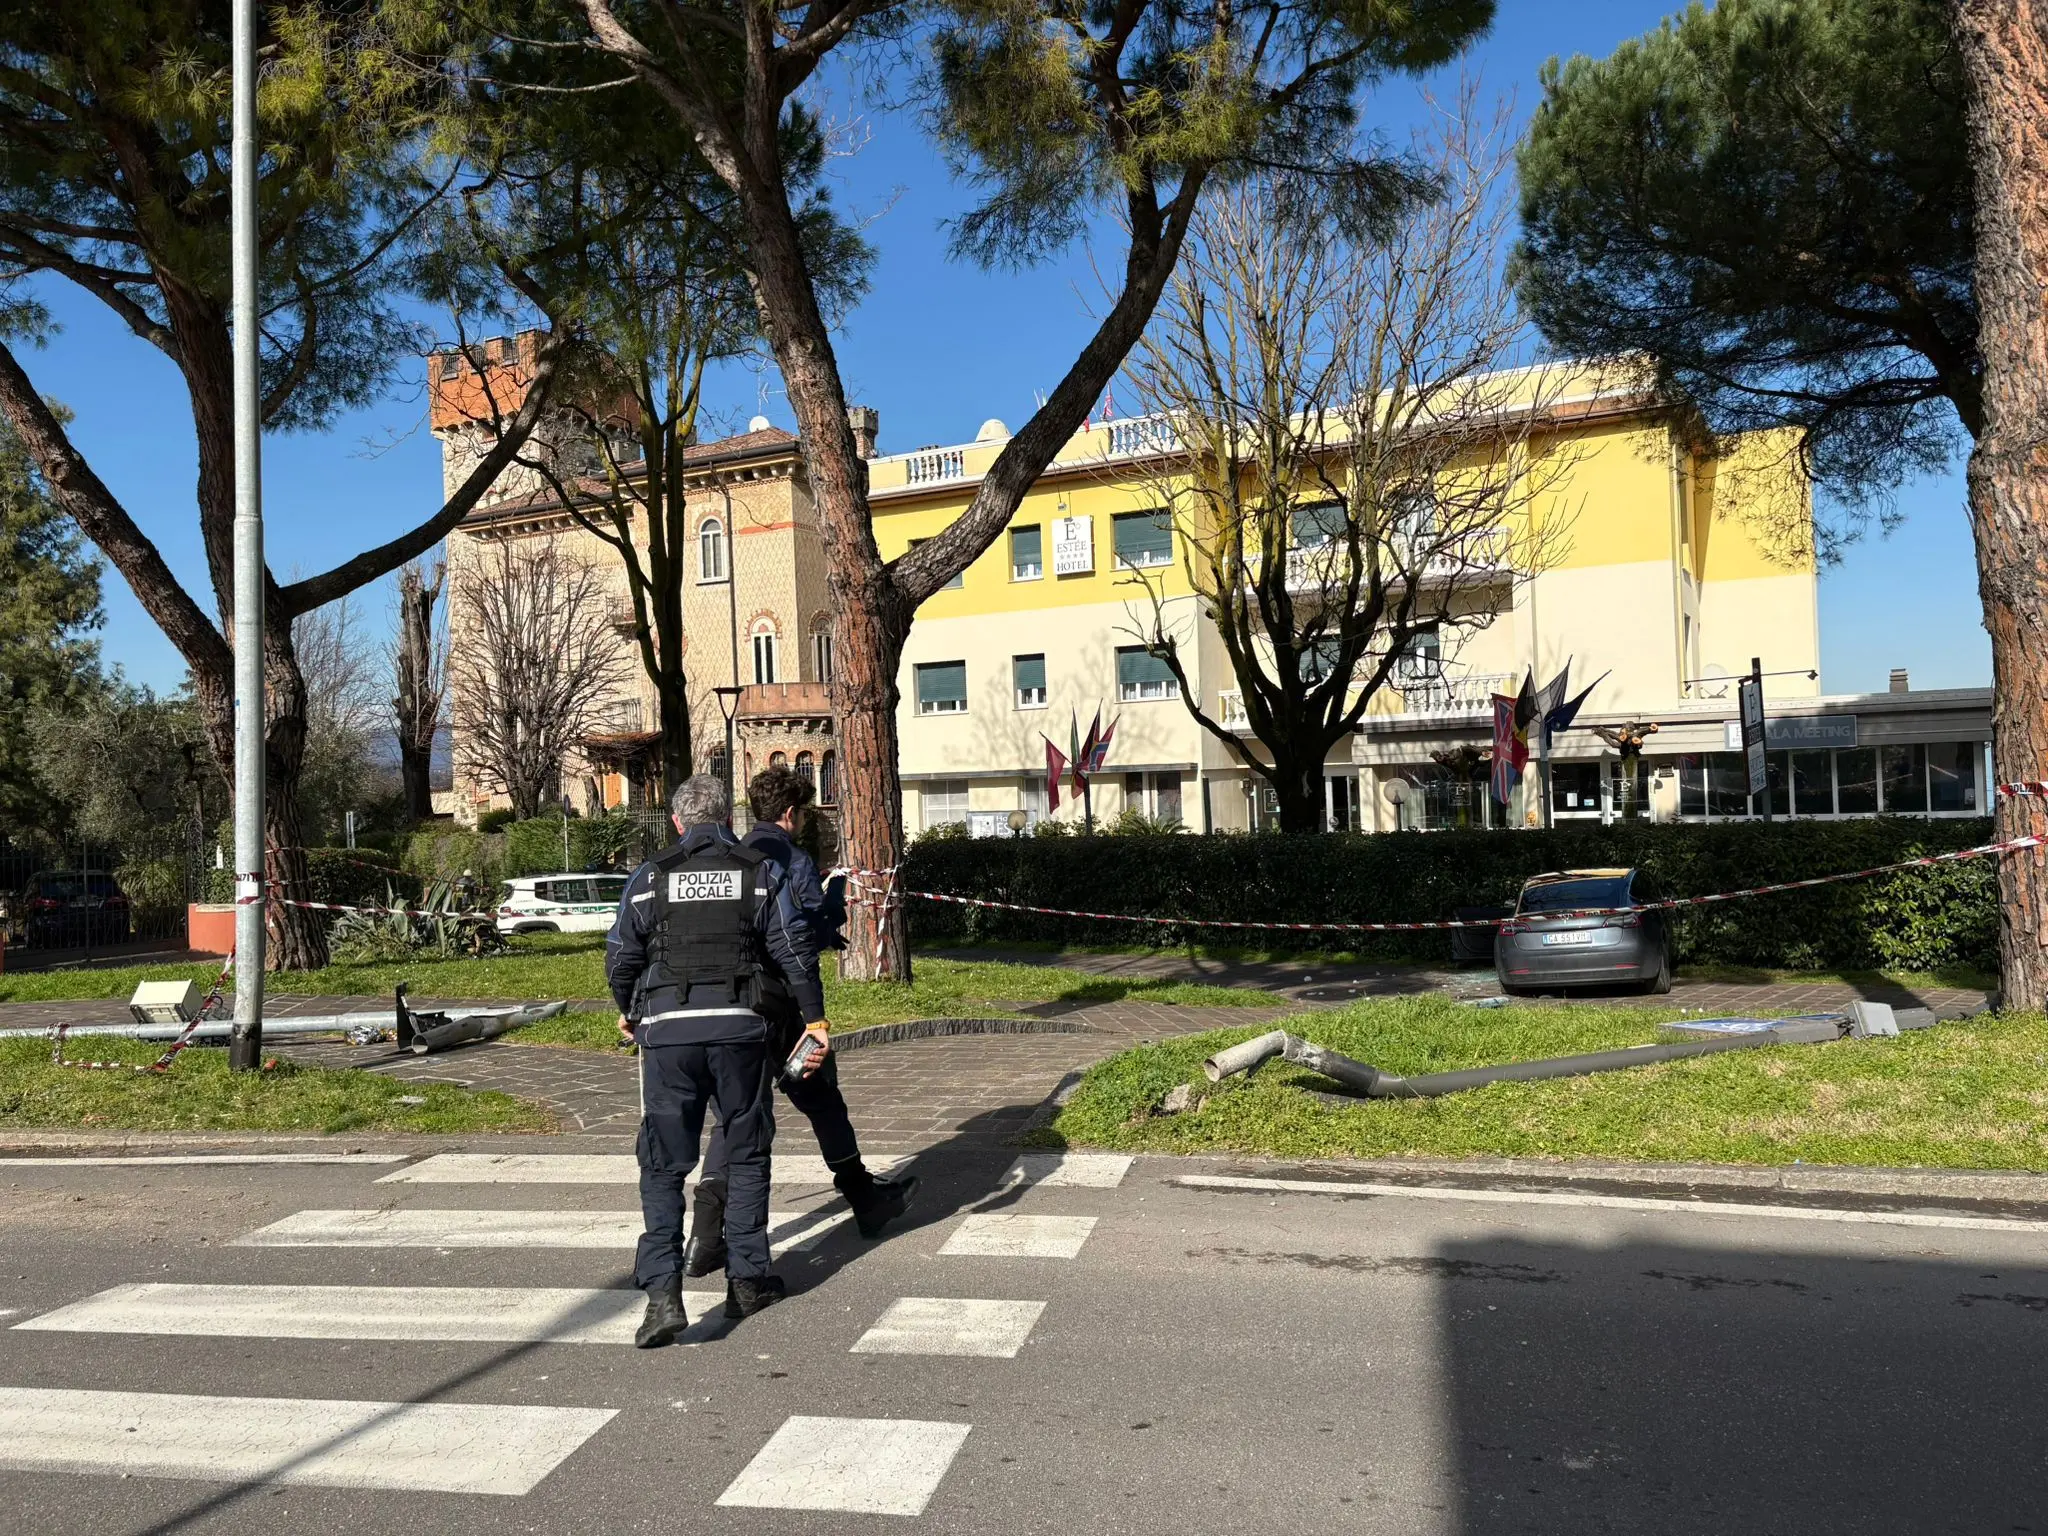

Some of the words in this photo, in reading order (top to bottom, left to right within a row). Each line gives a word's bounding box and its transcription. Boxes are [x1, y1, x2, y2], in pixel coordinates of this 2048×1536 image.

[1057, 560, 1089, 572] HOTEL
[1794, 725, 1851, 739] MEETING
[679, 872, 732, 886] POLIZIA
[678, 886, 733, 900] LOCALE
